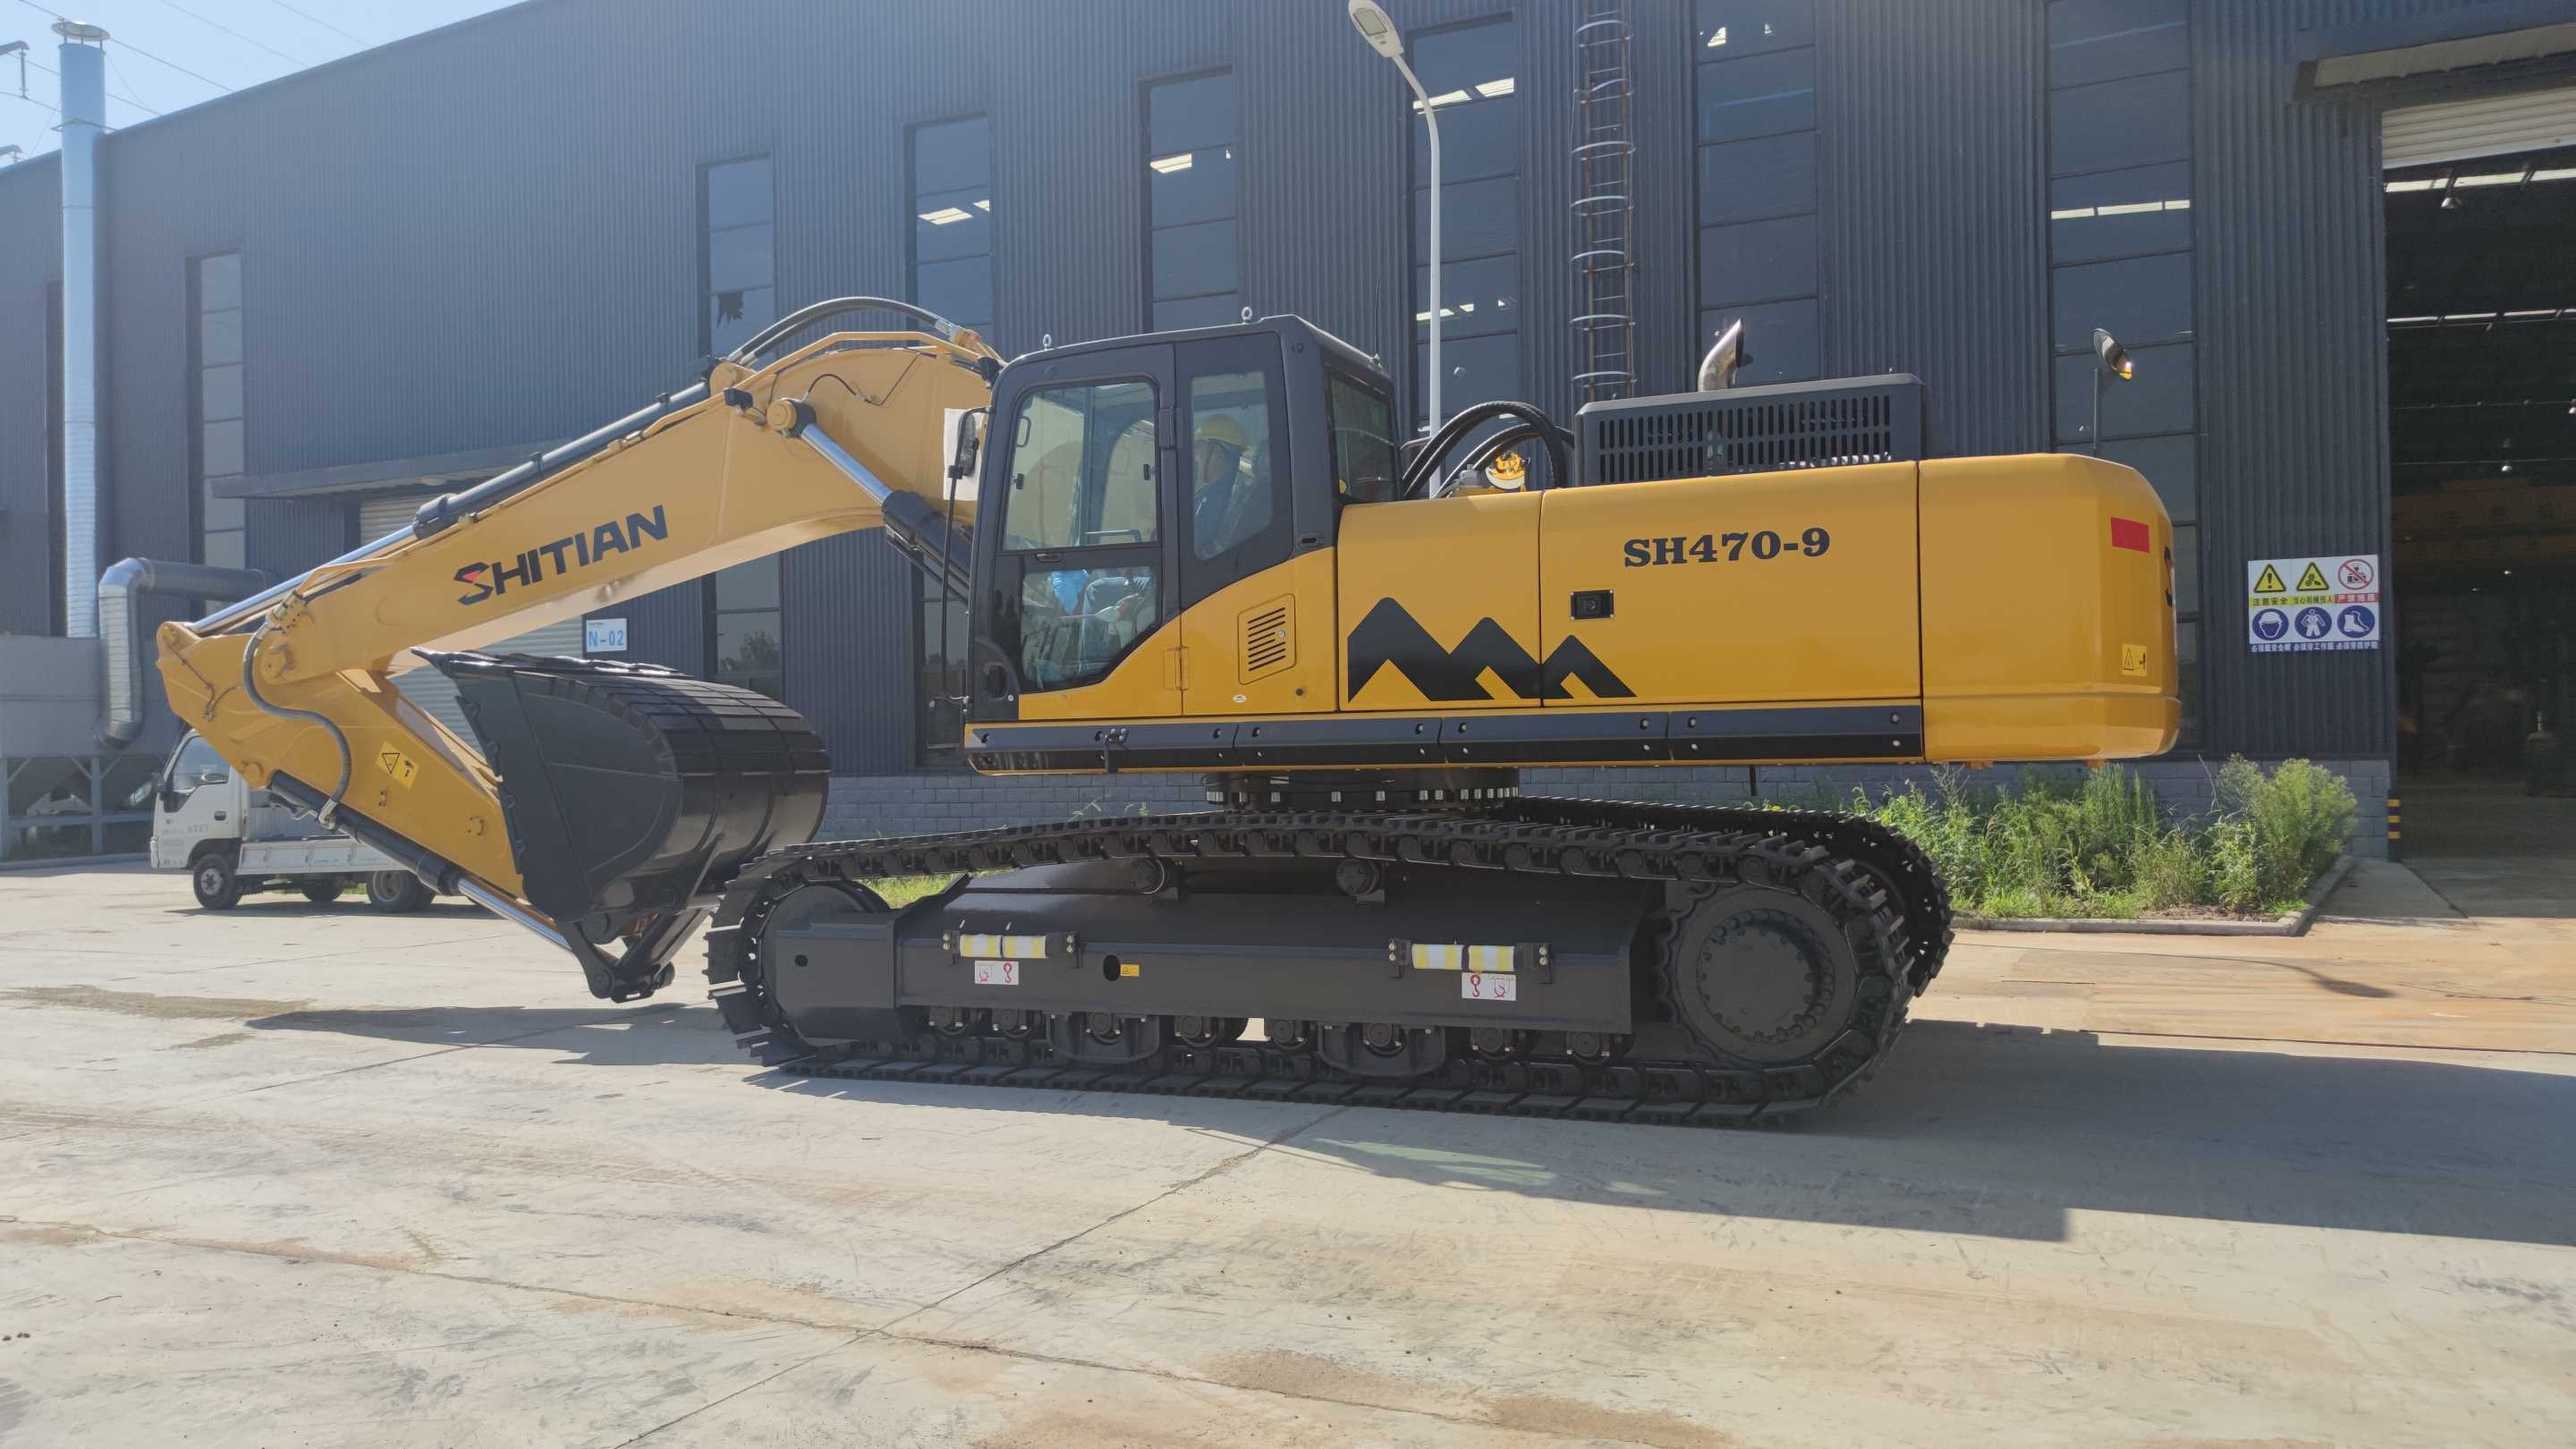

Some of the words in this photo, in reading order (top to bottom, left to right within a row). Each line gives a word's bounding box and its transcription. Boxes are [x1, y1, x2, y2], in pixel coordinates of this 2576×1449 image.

[453, 504, 669, 606] SHITIAN
[1623, 527, 1831, 568] SH470-9
[589, 629, 624, 648] N-02
